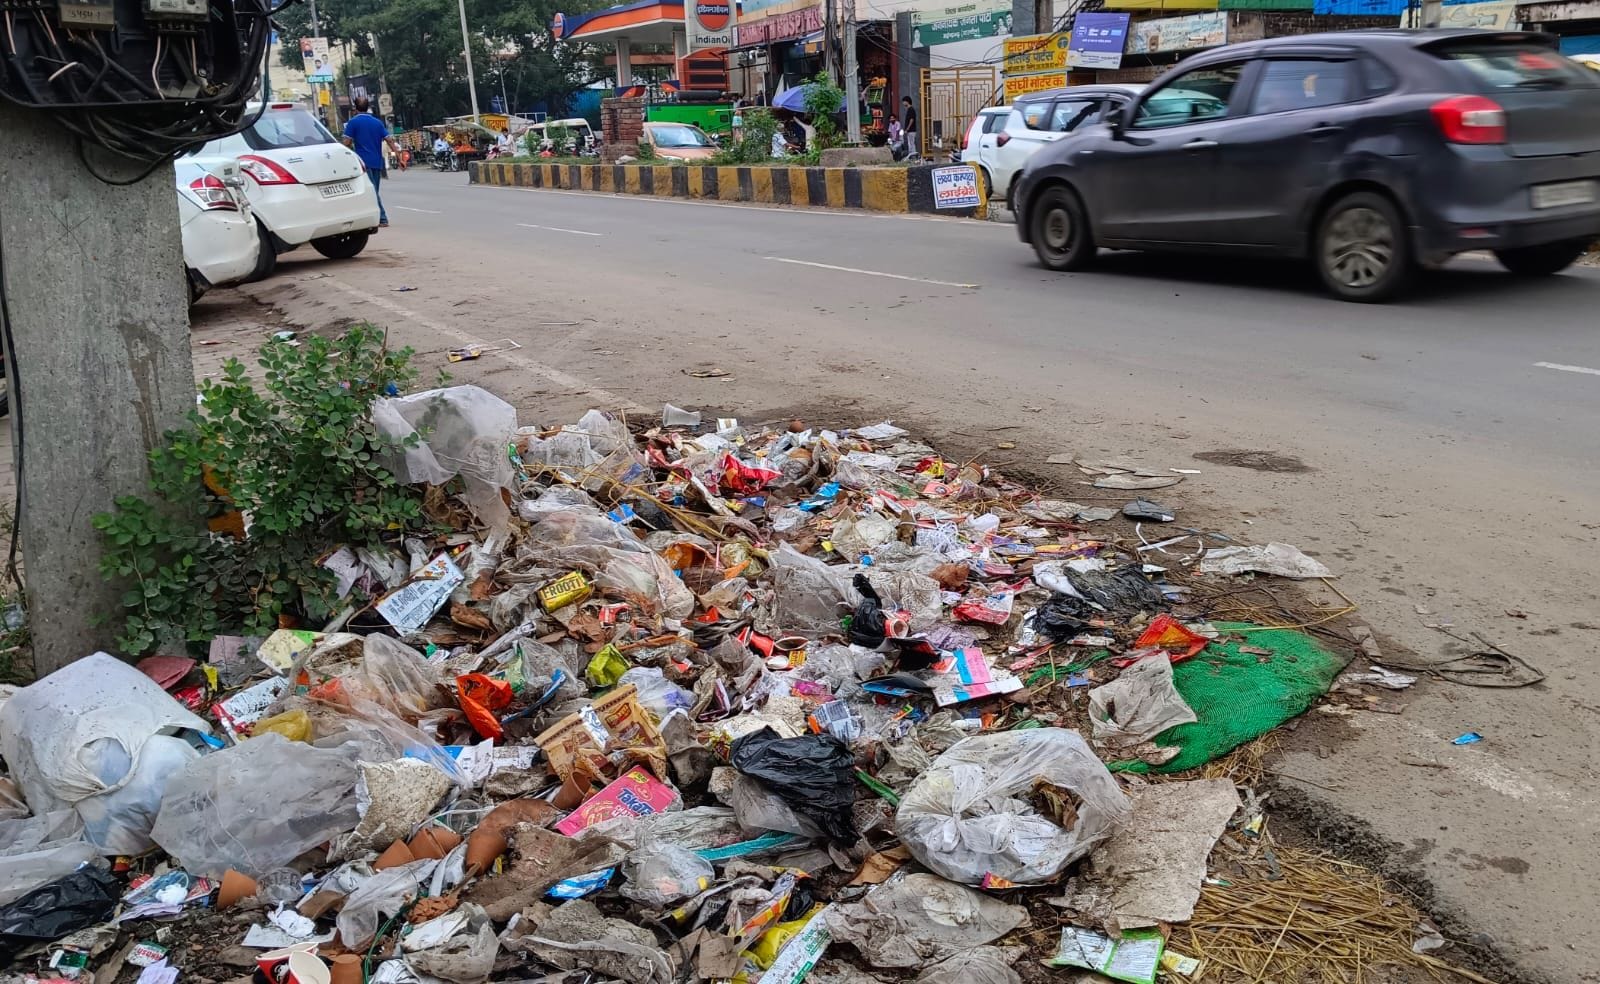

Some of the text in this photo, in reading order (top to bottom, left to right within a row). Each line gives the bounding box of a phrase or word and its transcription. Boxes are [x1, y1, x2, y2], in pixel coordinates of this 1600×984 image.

[776, 7, 822, 38] HOSPITA
[695, 35, 731, 44] IndianOi
[540, 577, 582, 599] FROOTI
[617, 787, 655, 816] TakaTa
